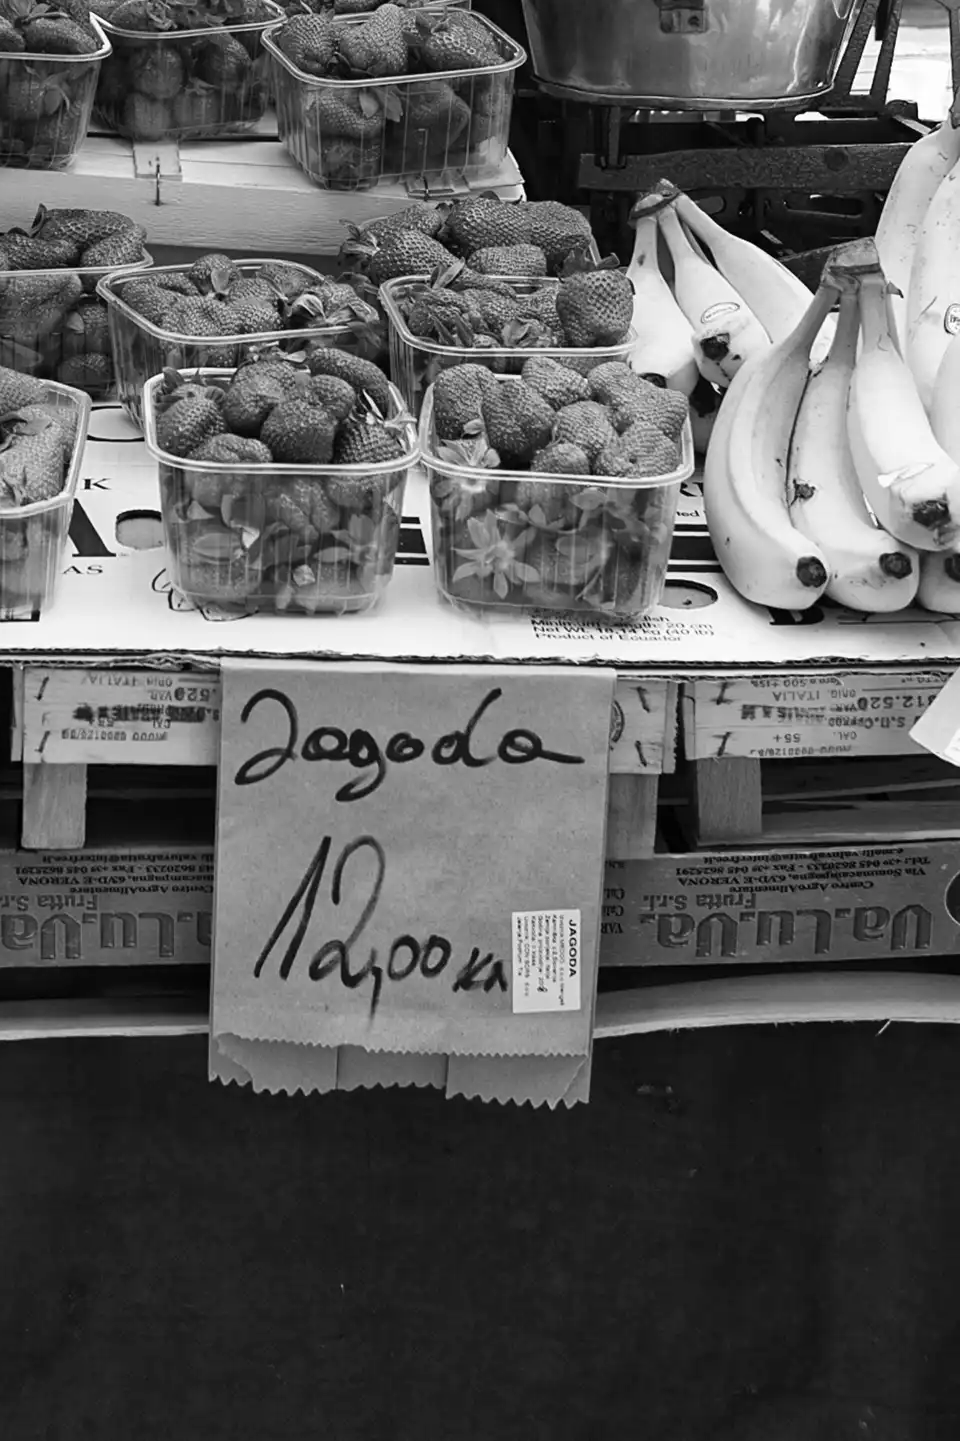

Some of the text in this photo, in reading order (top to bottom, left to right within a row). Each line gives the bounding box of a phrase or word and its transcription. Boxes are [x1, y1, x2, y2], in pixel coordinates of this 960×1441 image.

[535, 633, 595, 641] Product
[772, 689, 821, 702] ITALIA
[66, 865, 88, 875] 045
[110, 865, 135, 875] Fax
[726, 864, 749, 875] 045
[772, 862, 797, 873] Fax
[858, 859, 882, 870] 045
[903, 866, 927, 878] Via
[17, 876, 80, 886] VERONA
[677, 875, 742, 888] VERONA
[829, 879, 875, 892] Centro
[170, 884, 214, 895] Centro
[36, 893, 98, 912] Frutta
[643, 892, 757, 912] Frutta S.r.l.
[568, 918, 578, 978] JAGODA
